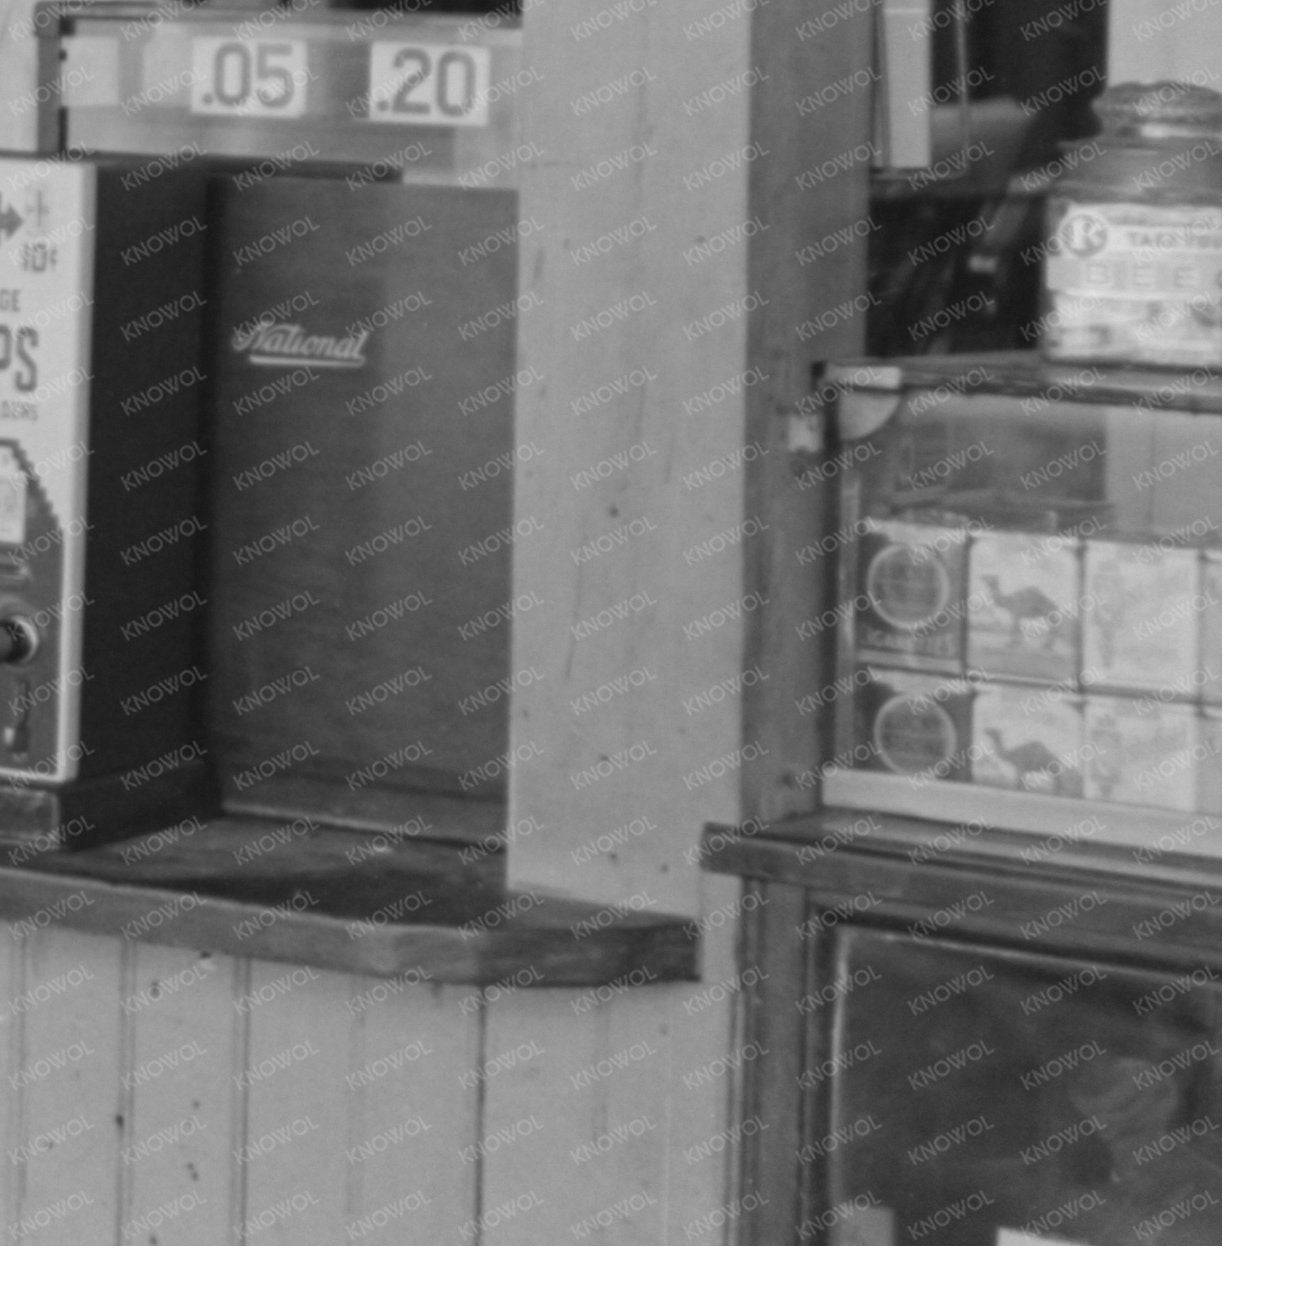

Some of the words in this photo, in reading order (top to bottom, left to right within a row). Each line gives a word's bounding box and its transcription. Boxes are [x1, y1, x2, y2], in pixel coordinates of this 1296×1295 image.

[201, 41, 295, 109] .05
[377, 48, 477, 117] .20
[230, 320, 370, 362] National
